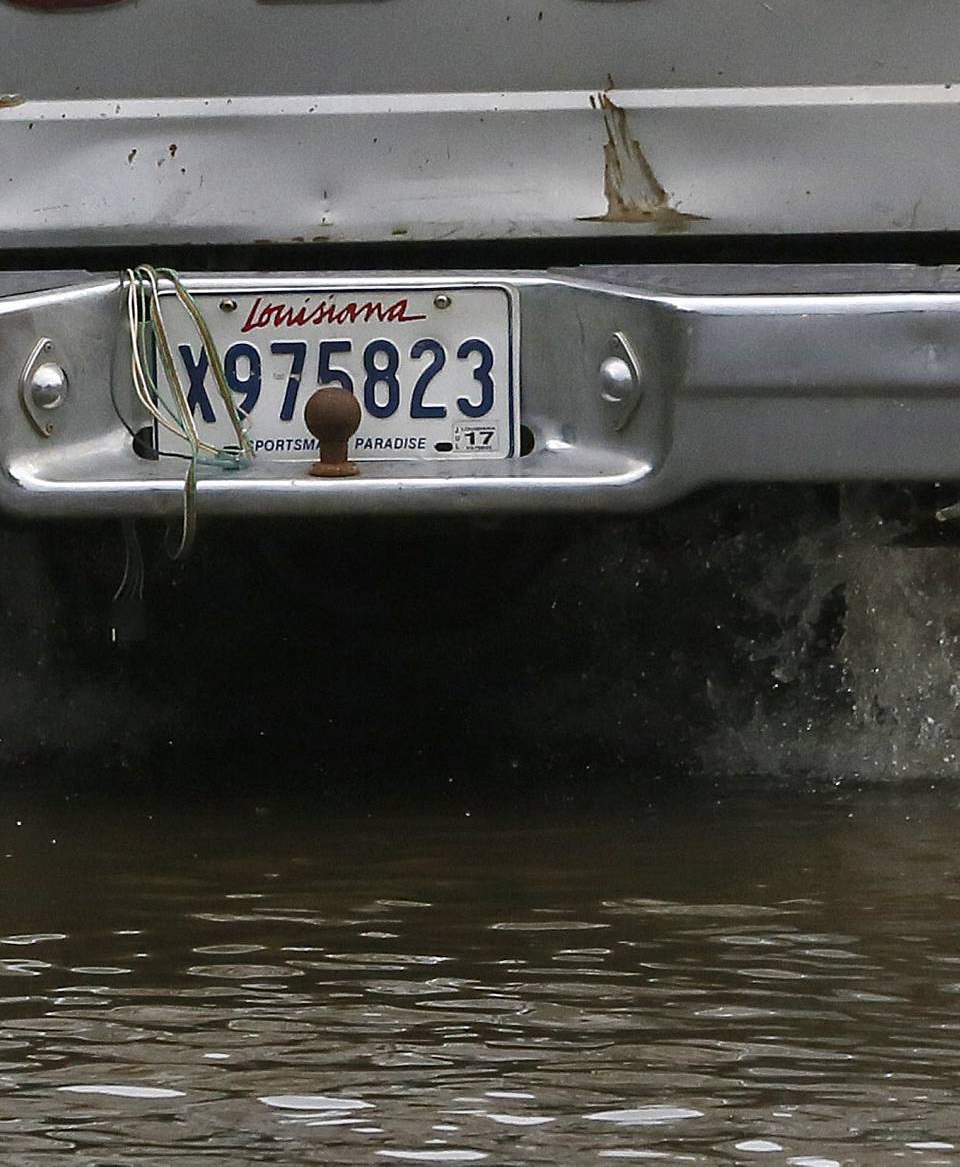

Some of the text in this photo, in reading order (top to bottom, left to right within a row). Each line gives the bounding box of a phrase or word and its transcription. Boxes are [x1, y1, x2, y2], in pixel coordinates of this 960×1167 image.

[241, 294, 426, 333] Louisiana
[178, 338, 495, 423] X975823
[249, 437, 427, 452] PORTSM PARADISE
[464, 431, 495, 446] 17
